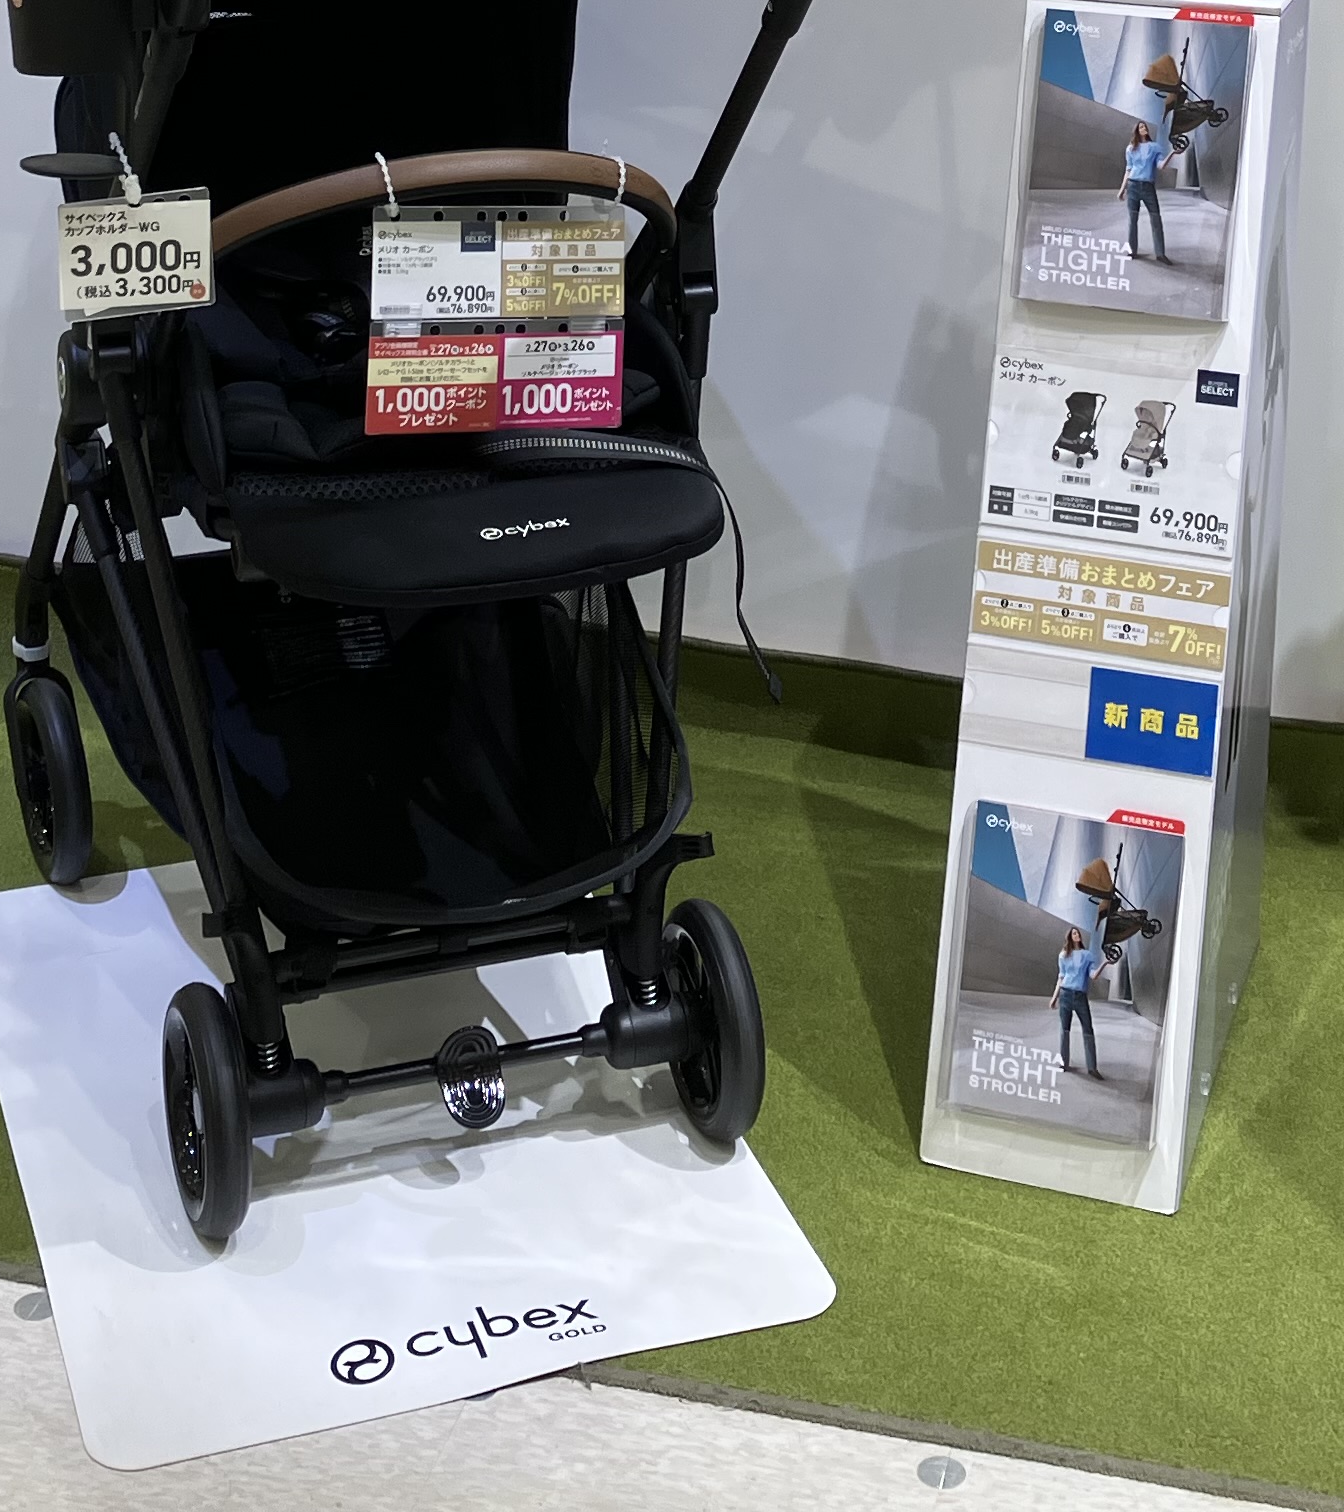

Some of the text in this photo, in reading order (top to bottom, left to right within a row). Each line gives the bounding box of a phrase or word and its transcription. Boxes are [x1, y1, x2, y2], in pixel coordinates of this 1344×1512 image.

[64, 211, 128, 225] サイベックス
[64, 222, 161, 237] カップホルダーWG
[464, 235, 493, 244] SELECT
[506, 228, 620, 240] 出産準備おまとめフェア
[377, 245, 434, 254] メリオ カーボン
[1040, 232, 1132, 254] THE ULTRA
[70, 239, 201, 277] 3,000円
[1039, 245, 1132, 275] LIGHT
[1038, 268, 1130, 291] STROLLER
[426, 286, 495, 303] 69,900円
[552, 282, 621, 306] 7%OFF!
[1012, 358, 1044, 371] cybex
[999, 371, 1067, 386] メリオ カーボン
[375, 387, 487, 413] 1,000 ポイント
[502, 383, 610, 415] 1,000 ポイント
[1200, 385, 1234, 397] SELECT
[446, 399, 487, 410] クーポン
[573, 400, 614, 411] プレゼント
[398, 414, 458, 428] プレゼント
[504, 518, 570, 538] cybex
[1149, 507, 1229, 534] 69,900円
[992, 549, 1215, 599] 出産準備おまとめフェア
[1057, 584, 1145, 612] 対象商品
[980, 610, 1032, 633] 3%OFF!
[1041, 619, 1093, 642] 5%OFF!
[1103, 701, 1200, 740] 新商品
[997, 815, 1034, 833] cybex
[972, 1036, 1064, 1066] THE ULTRA
[971, 1051, 1064, 1087] LIGHT
[968, 1075, 1062, 1105] STROLLER
[406, 1299, 599, 1359] cybex
[548, 1324, 607, 1342] GOLD
